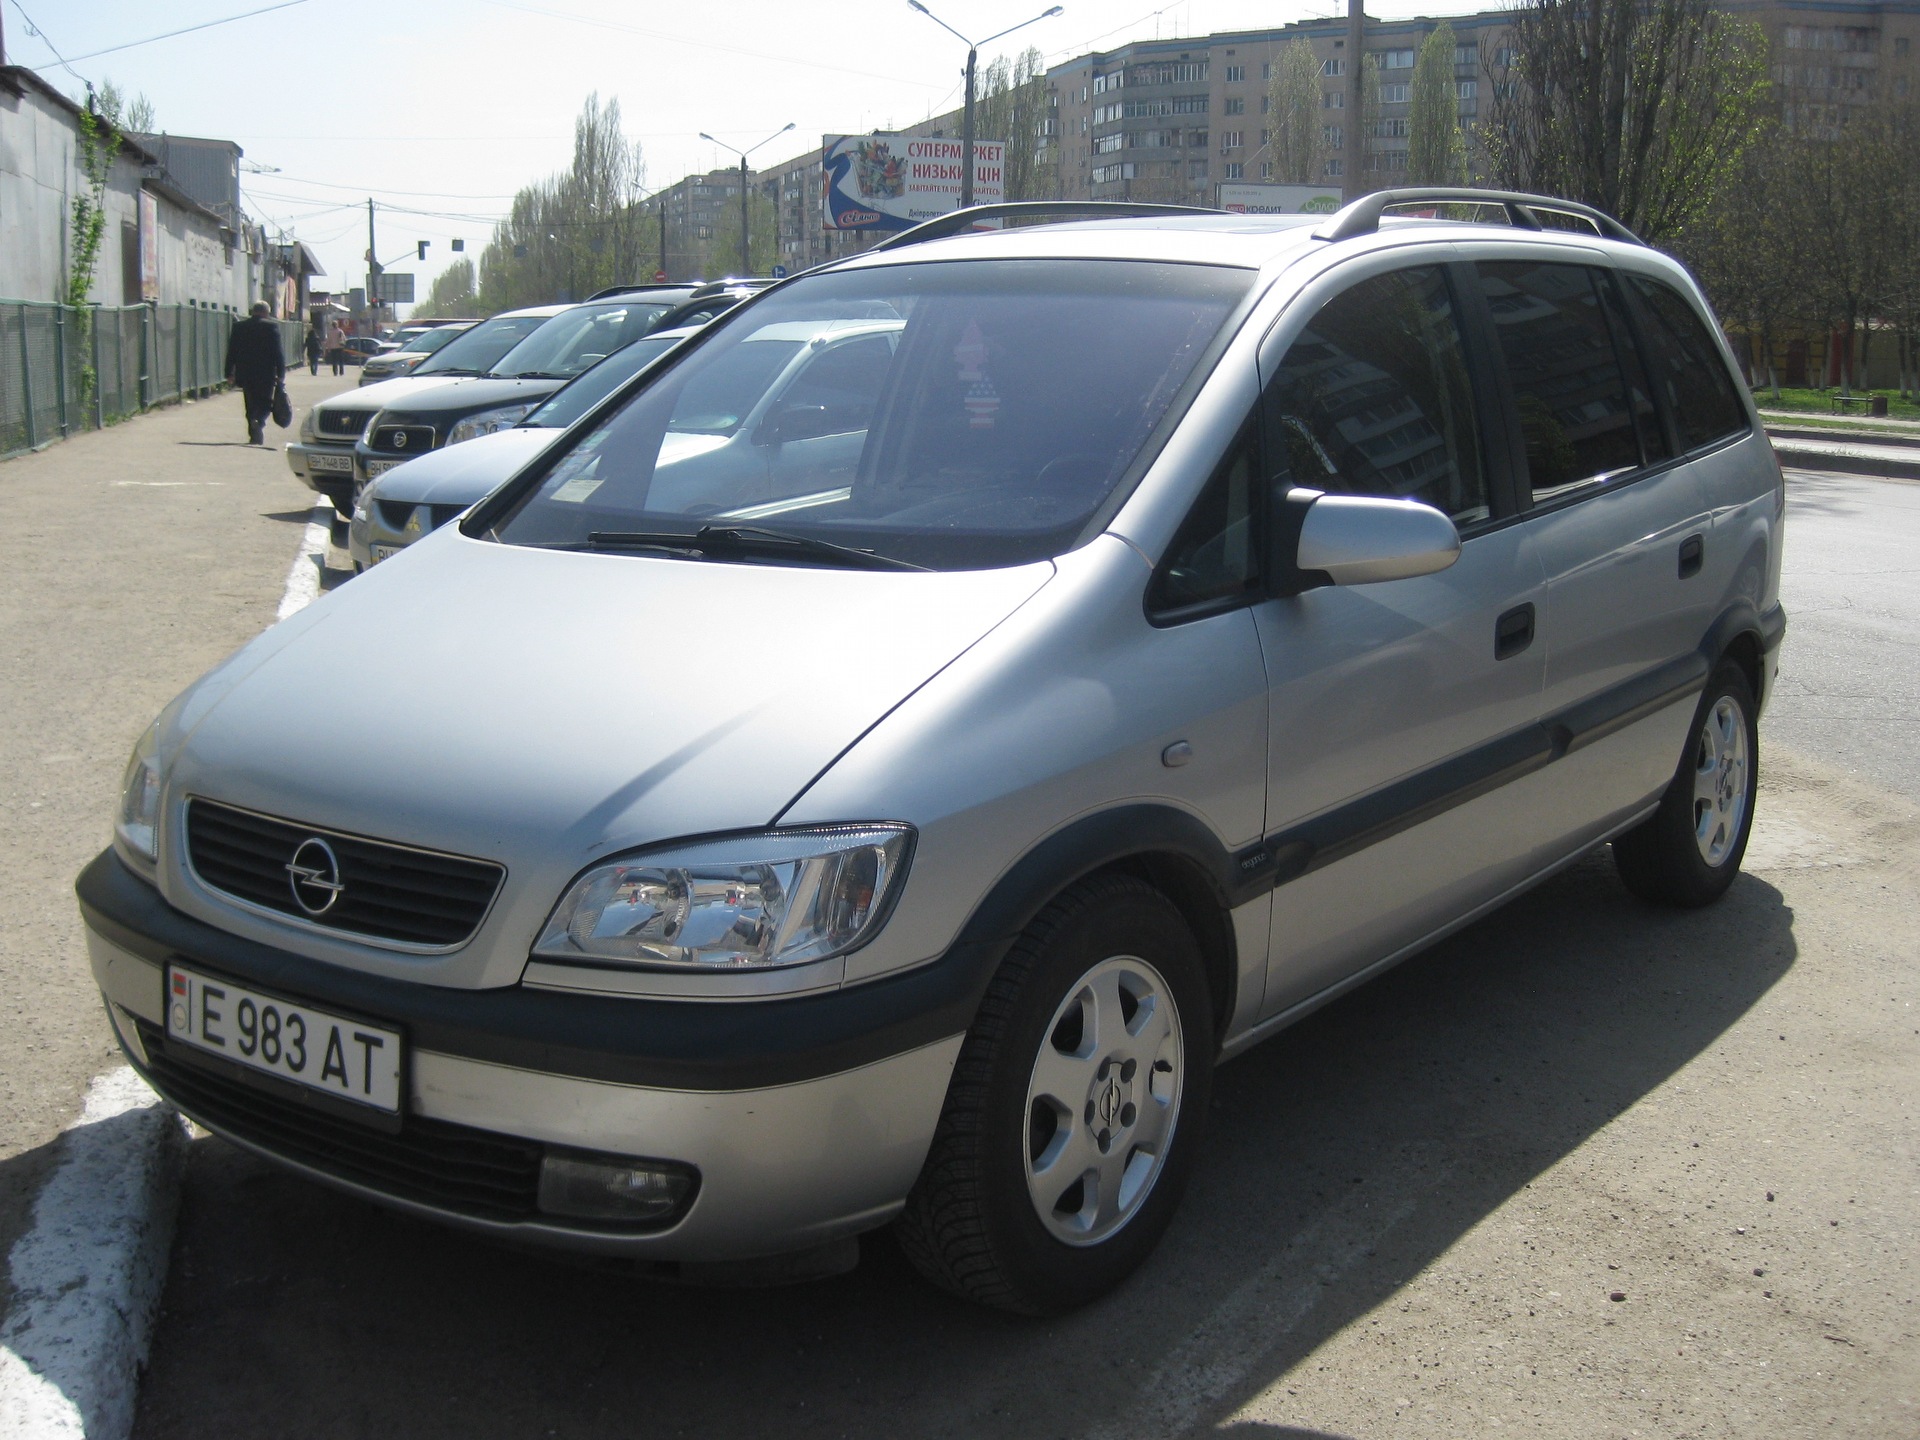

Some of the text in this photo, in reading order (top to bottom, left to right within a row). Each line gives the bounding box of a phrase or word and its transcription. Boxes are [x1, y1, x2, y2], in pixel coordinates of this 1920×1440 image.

[908, 142, 1002, 161] СУПЕРМРКЕТ
[912, 163, 1001, 184] НИЗЬКИ ЦІН
[950, 186, 1000, 196] ПЕРНАЙТЕСЬ
[203, 984, 384, 1095] E 983 AT
